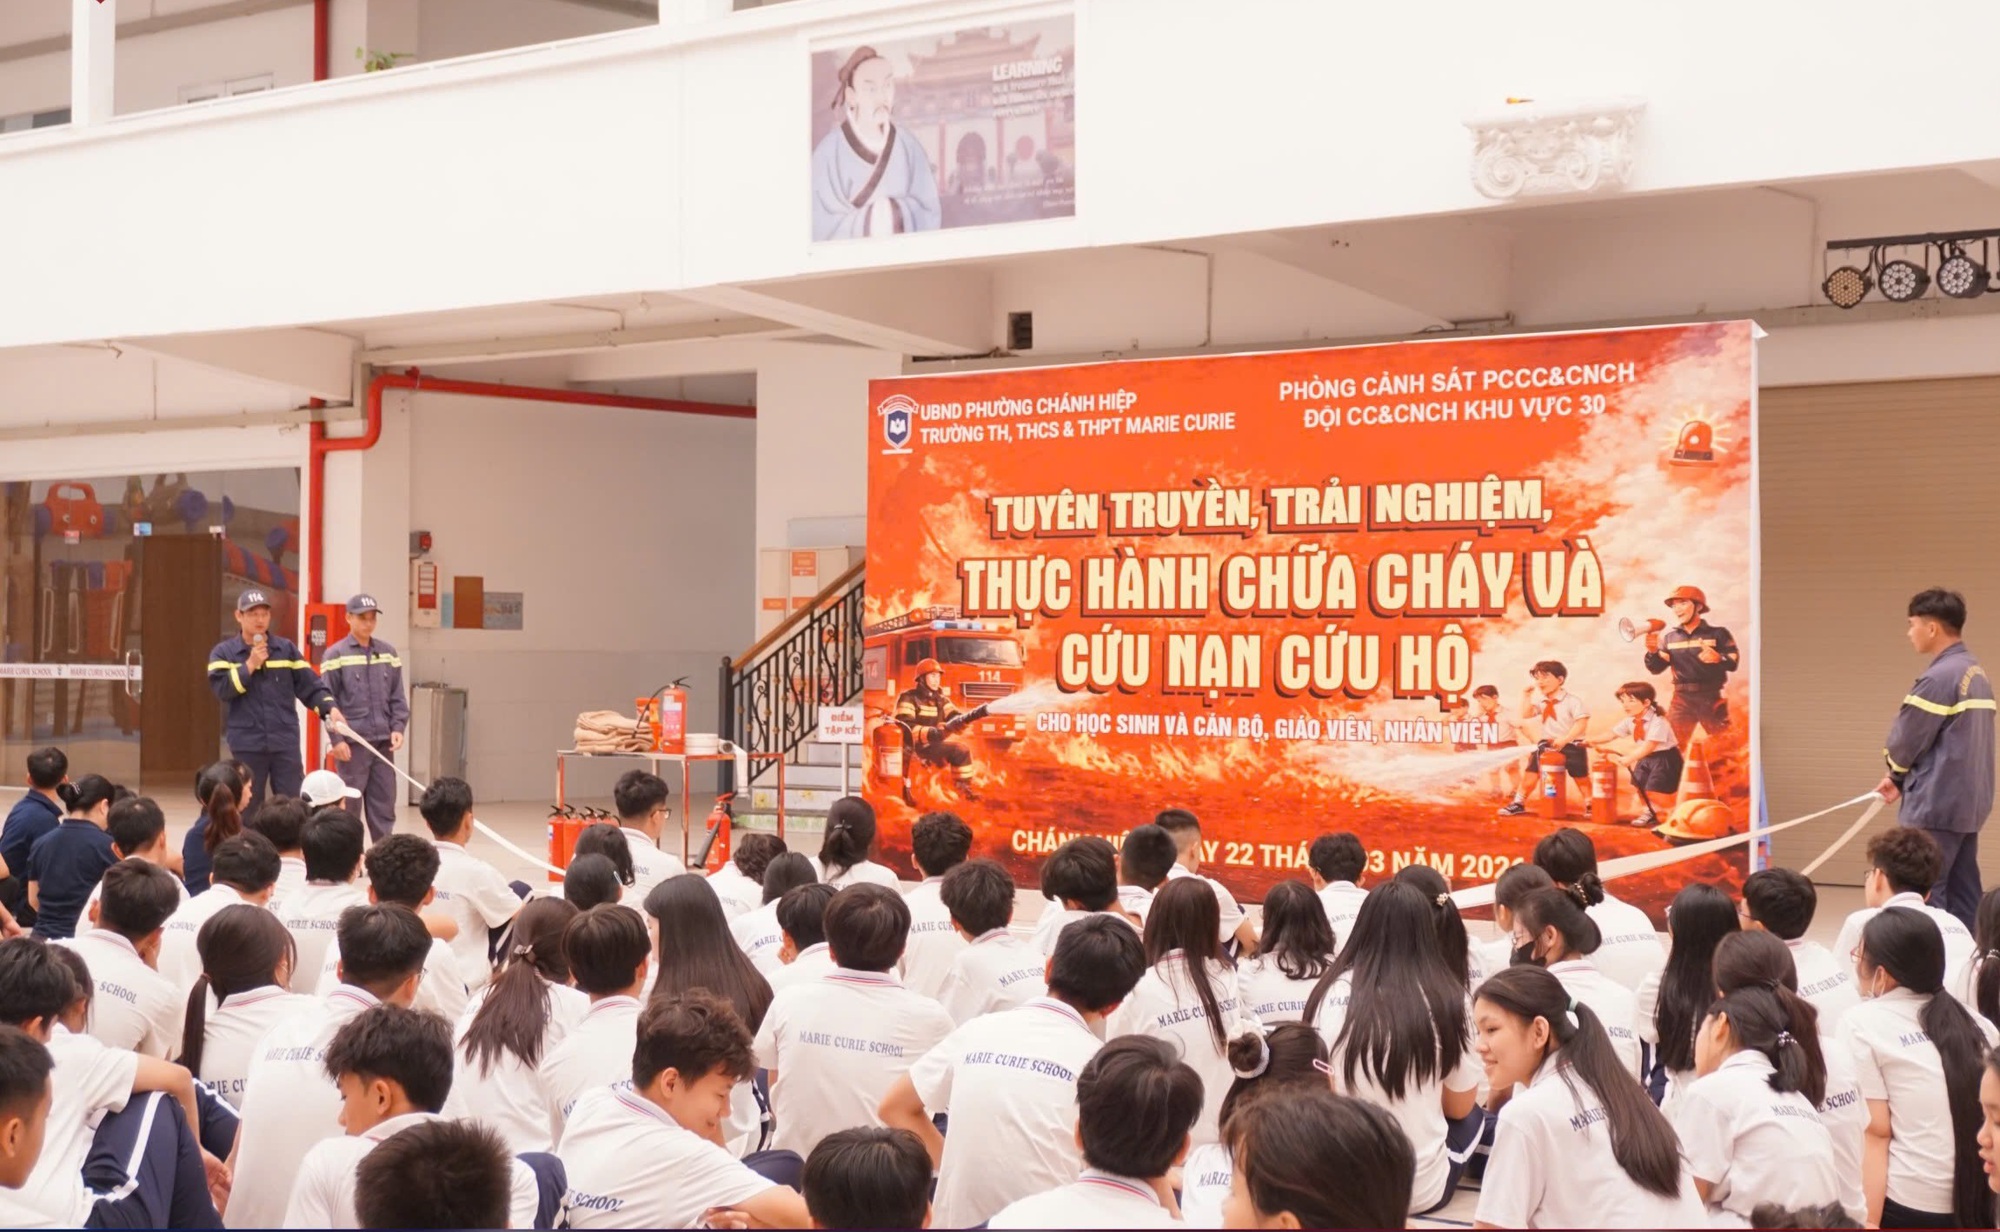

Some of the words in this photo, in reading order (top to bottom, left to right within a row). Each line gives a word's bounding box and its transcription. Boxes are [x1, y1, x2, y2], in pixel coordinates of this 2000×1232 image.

[993, 56, 1063, 81] LEARNING
[1279, 374, 1357, 401] PHÒNG
[1362, 370, 1425, 397] CẢNH
[1431, 366, 1477, 393] SÁT
[1482, 361, 1636, 391] PCCC&CNCH
[920, 402, 963, 421] UBND
[965, 396, 1033, 419] PHƯỜNG
[1036, 391, 1096, 415] CHÁNH
[1098, 388, 1138, 413] HIỆP
[1303, 404, 1341, 432] ĐỘI
[1346, 401, 1459, 426] CC&CNCH
[1464, 398, 1513, 421] KHU
[1519, 395, 1573, 422] VỰC
[1578, 393, 1607, 416] 30
[920, 422, 985, 444] TRƯỜNG
[987, 424, 1013, 444] TH,
[1015, 421, 1060, 440] THCS
[1062, 420, 1075, 438] &
[1077, 417, 1122, 437] THPT
[1125, 414, 1181, 434] MARIE
[1183, 411, 1236, 432] CURIE
[990, 487, 1099, 533] TUYÊN
[1109, 477, 1260, 532] TRUYỀN,
[1270, 477, 1362, 527] TRẢI
[1374, 474, 1554, 529] NGHIỆM,
[963, 558, 1071, 620] THỰC
[1087, 546, 1209, 611] HÀNH
[1226, 543, 1356, 611] CHỮA
[1375, 540, 1514, 611] CHÁY
[1533, 537, 1603, 609] VÀ
[1060, 625, 1148, 689] CỨU
[1168, 634, 1261, 699] NẠN
[1280, 623, 1379, 691] CỨU
[1400, 624, 1472, 698] HỘ
[978, 670, 1001, 683] 114
[830, 710, 854, 722] ĐIỂM
[1036, 711, 1072, 733] CHO
[1075, 713, 1112, 738] HỌC
[1116, 713, 1161, 736] SINH
[1164, 711, 1189, 737] VÀ
[1193, 712, 1232, 738] CÁN
[1237, 713, 1270, 743] BỘ,
[1275, 714, 1321, 741] GIÁO
[1326, 714, 1379, 745] VIÊN,
[1384, 716, 1443, 743] NHÂN
[1449, 717, 1499, 744] VIÊN
[825, 726, 843, 737] TẬP
[844, 724, 862, 735] KẾT
[1224, 841, 1255, 866] 22
[1258, 840, 1310, 869] THÁ
[1363, 849, 1385, 873] 3
[1391, 846, 1455, 878] NĂM
[1460, 853, 1525, 880] 202
[310, 919, 340, 931] SCHOO
[910, 920, 935, 934] MARIE
[937, 920, 954, 932] CUR
[754, 934, 778, 950] MARIE
[998, 968, 1029, 988] MARIE
[99, 980, 137, 1005] SCHOOL
[1329, 996, 1350, 1007] MAR
[1157, 1007, 1191, 1028] MARIE
[1277, 1000, 1307, 1012] CURIE
[799, 1030, 832, 1047] MARIE
[834, 1036, 867, 1052] CURIE
[868, 1040, 904, 1058] SCHOOL
[964, 1051, 994, 1065] MARIE
[994, 1053, 1030, 1070] CURIE
[1030, 1059, 1075, 1082] SCHOOL
[1569, 1108, 1602, 1132] MARIE
[1197, 1171, 1232, 1188] MARIE
[575, 1192, 624, 1213] SCHOOL
